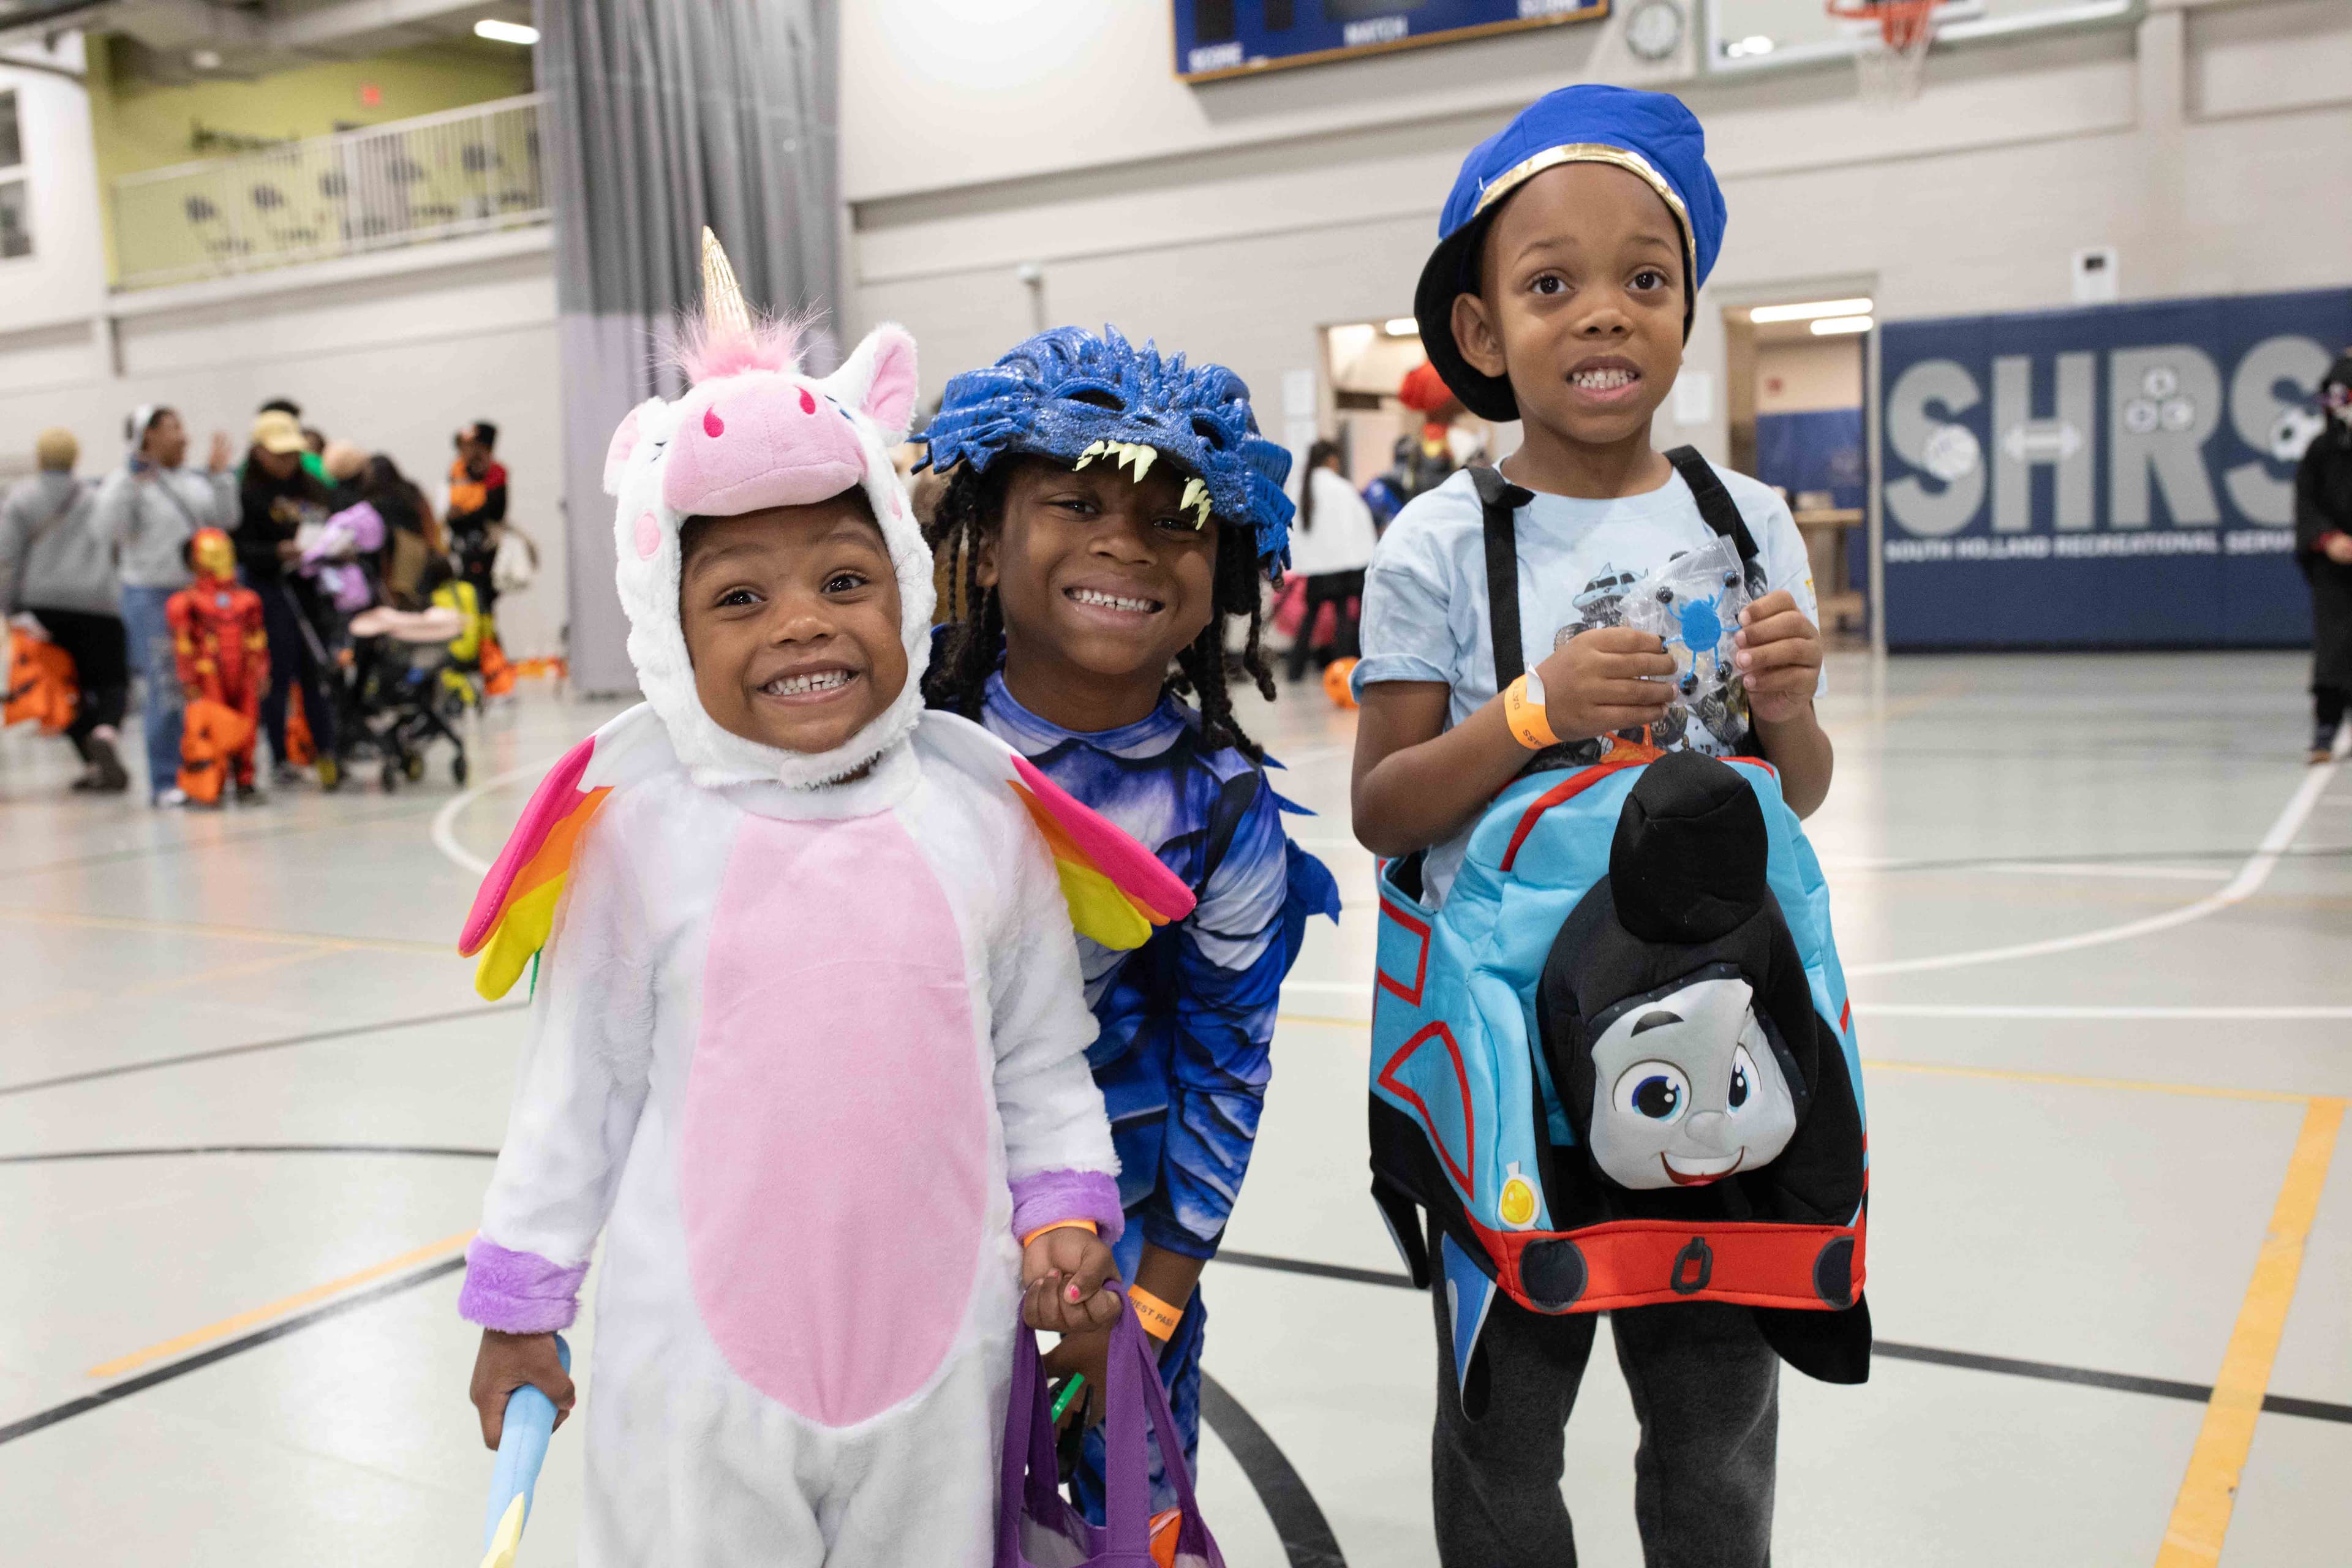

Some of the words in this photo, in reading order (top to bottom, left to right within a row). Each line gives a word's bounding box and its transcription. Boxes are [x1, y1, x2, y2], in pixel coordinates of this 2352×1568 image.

[1885, 335, 2332, 537] SHRS
[1885, 538, 1953, 563] SOUTH
[1955, 535, 2052, 560] HOLLAND
[2052, 531, 2218, 559] RECREATIONAL
